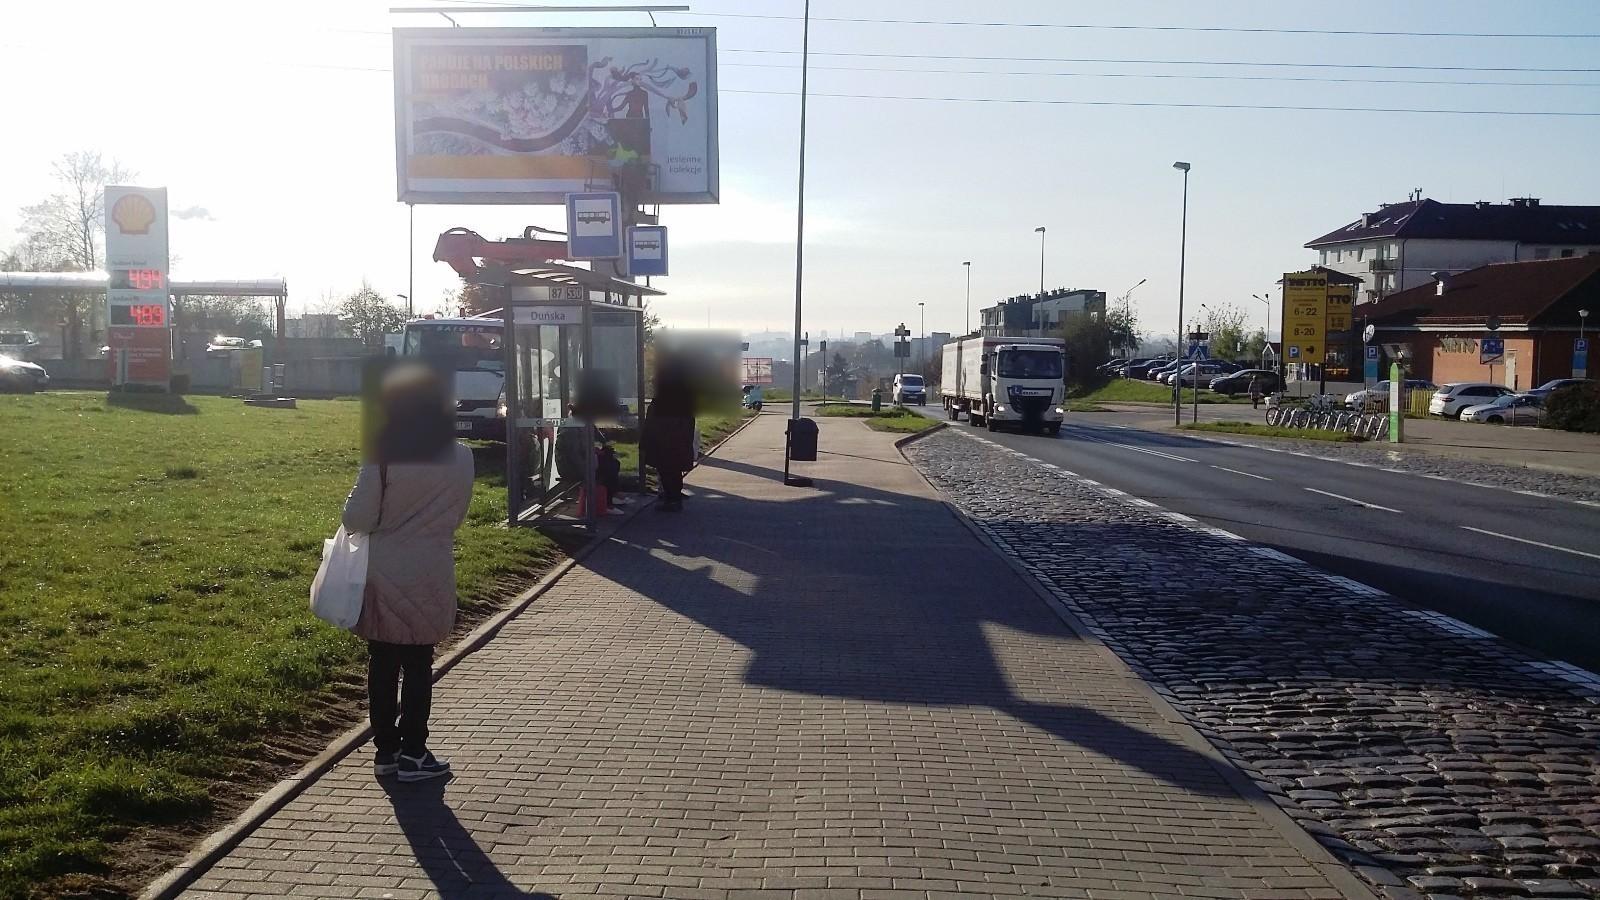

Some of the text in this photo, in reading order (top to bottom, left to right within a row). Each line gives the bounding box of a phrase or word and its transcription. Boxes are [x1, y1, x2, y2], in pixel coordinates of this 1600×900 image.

[473, 55, 493, 71] NA
[494, 55, 563, 71] POLSKICH
[552, 288, 582, 299] 87 530
[530, 311, 566, 321] Duńska
